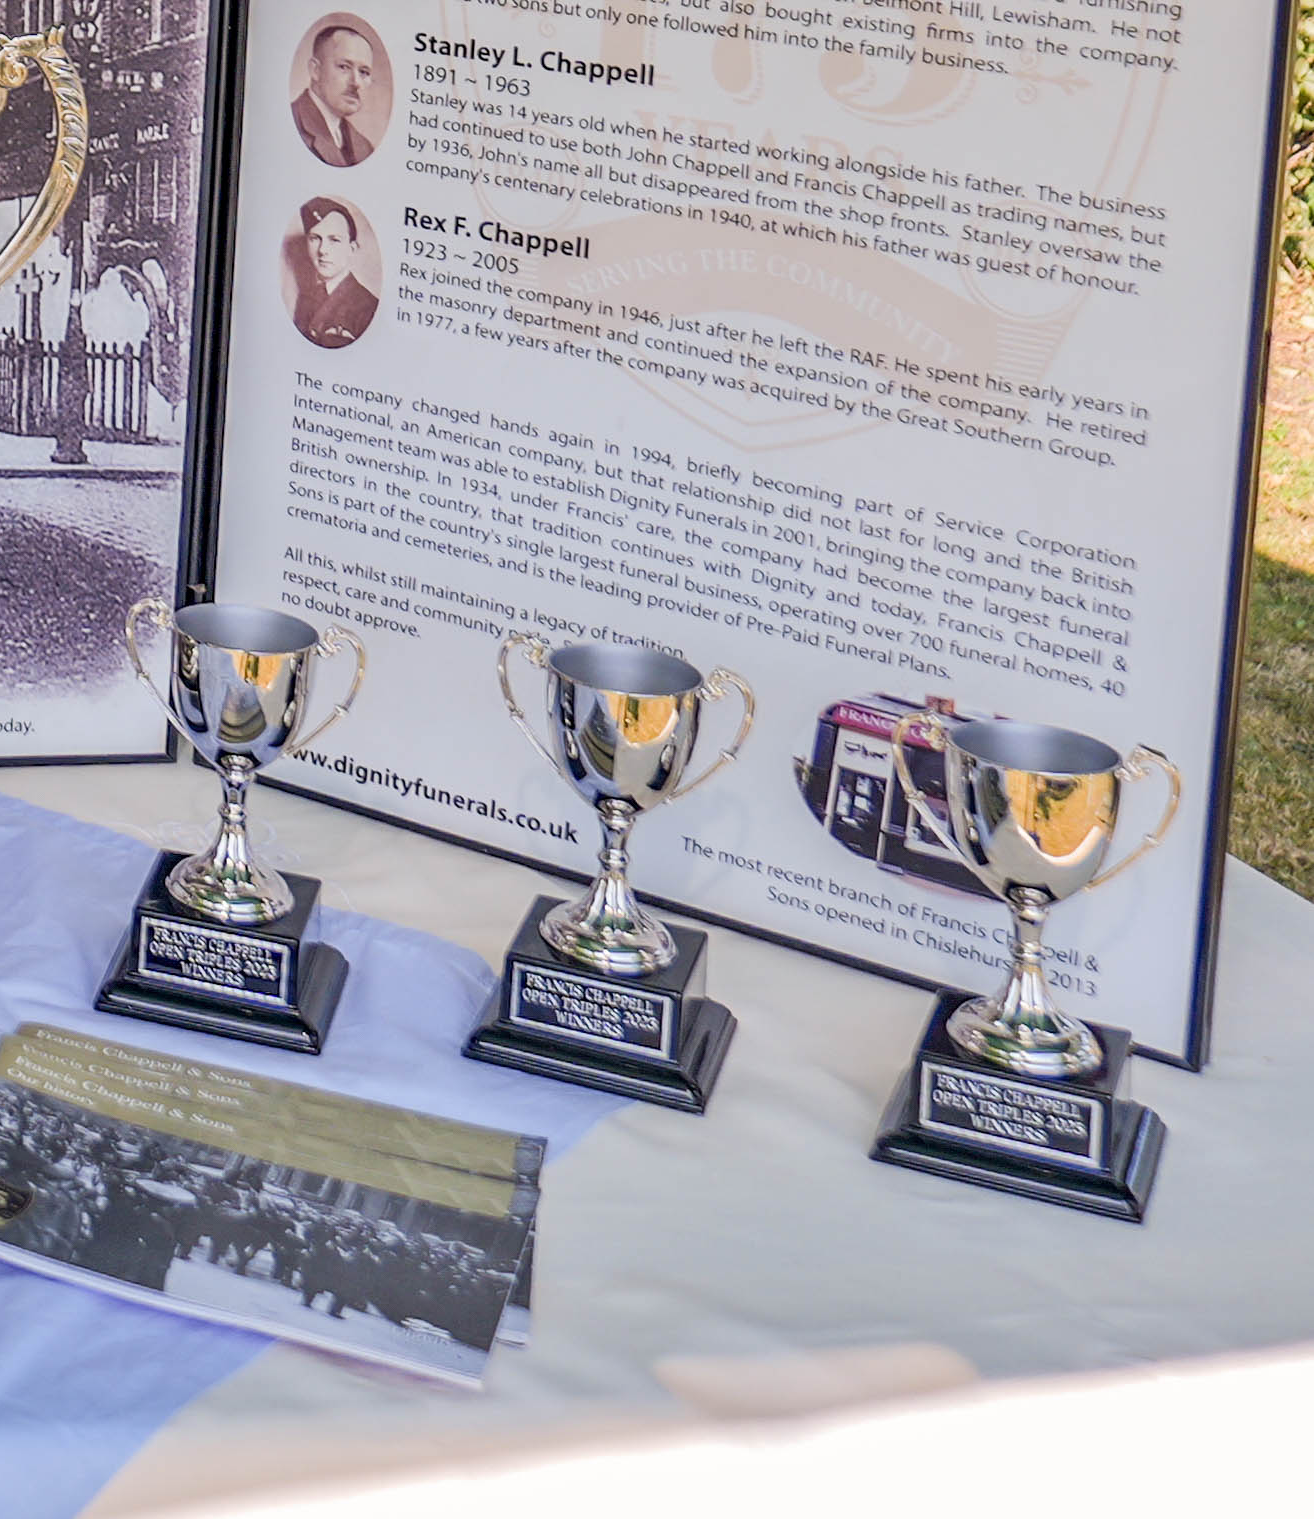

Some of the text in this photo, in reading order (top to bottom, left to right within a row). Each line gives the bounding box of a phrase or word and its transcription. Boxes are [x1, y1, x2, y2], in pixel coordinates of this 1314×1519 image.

[414, 33, 654, 86] Stanley L. Chappell
[415, 64, 456, 86] 1891
[486, 74, 530, 97] 1963
[403, 238, 447, 261] 1923
[472, 251, 519, 275] 2005
[404, 207, 589, 259] Rex F. Chappell
[290, 744, 578, 844] ww.dignityfunerals.co.uk
[682, 836, 715, 859] The
[718, 851, 762, 874] most
[767, 865, 823, 892] recent
[828, 878, 892, 911] branch
[897, 903, 917, 918] of
[921, 906, 987, 939] Francis
[1084, 955, 1099, 973] &
[767, 886, 1097, 996] Sons opened in Chislehurs 2013
[179, 961, 245, 987] WINNERS
[555, 1010, 623, 1039] WINNERS
